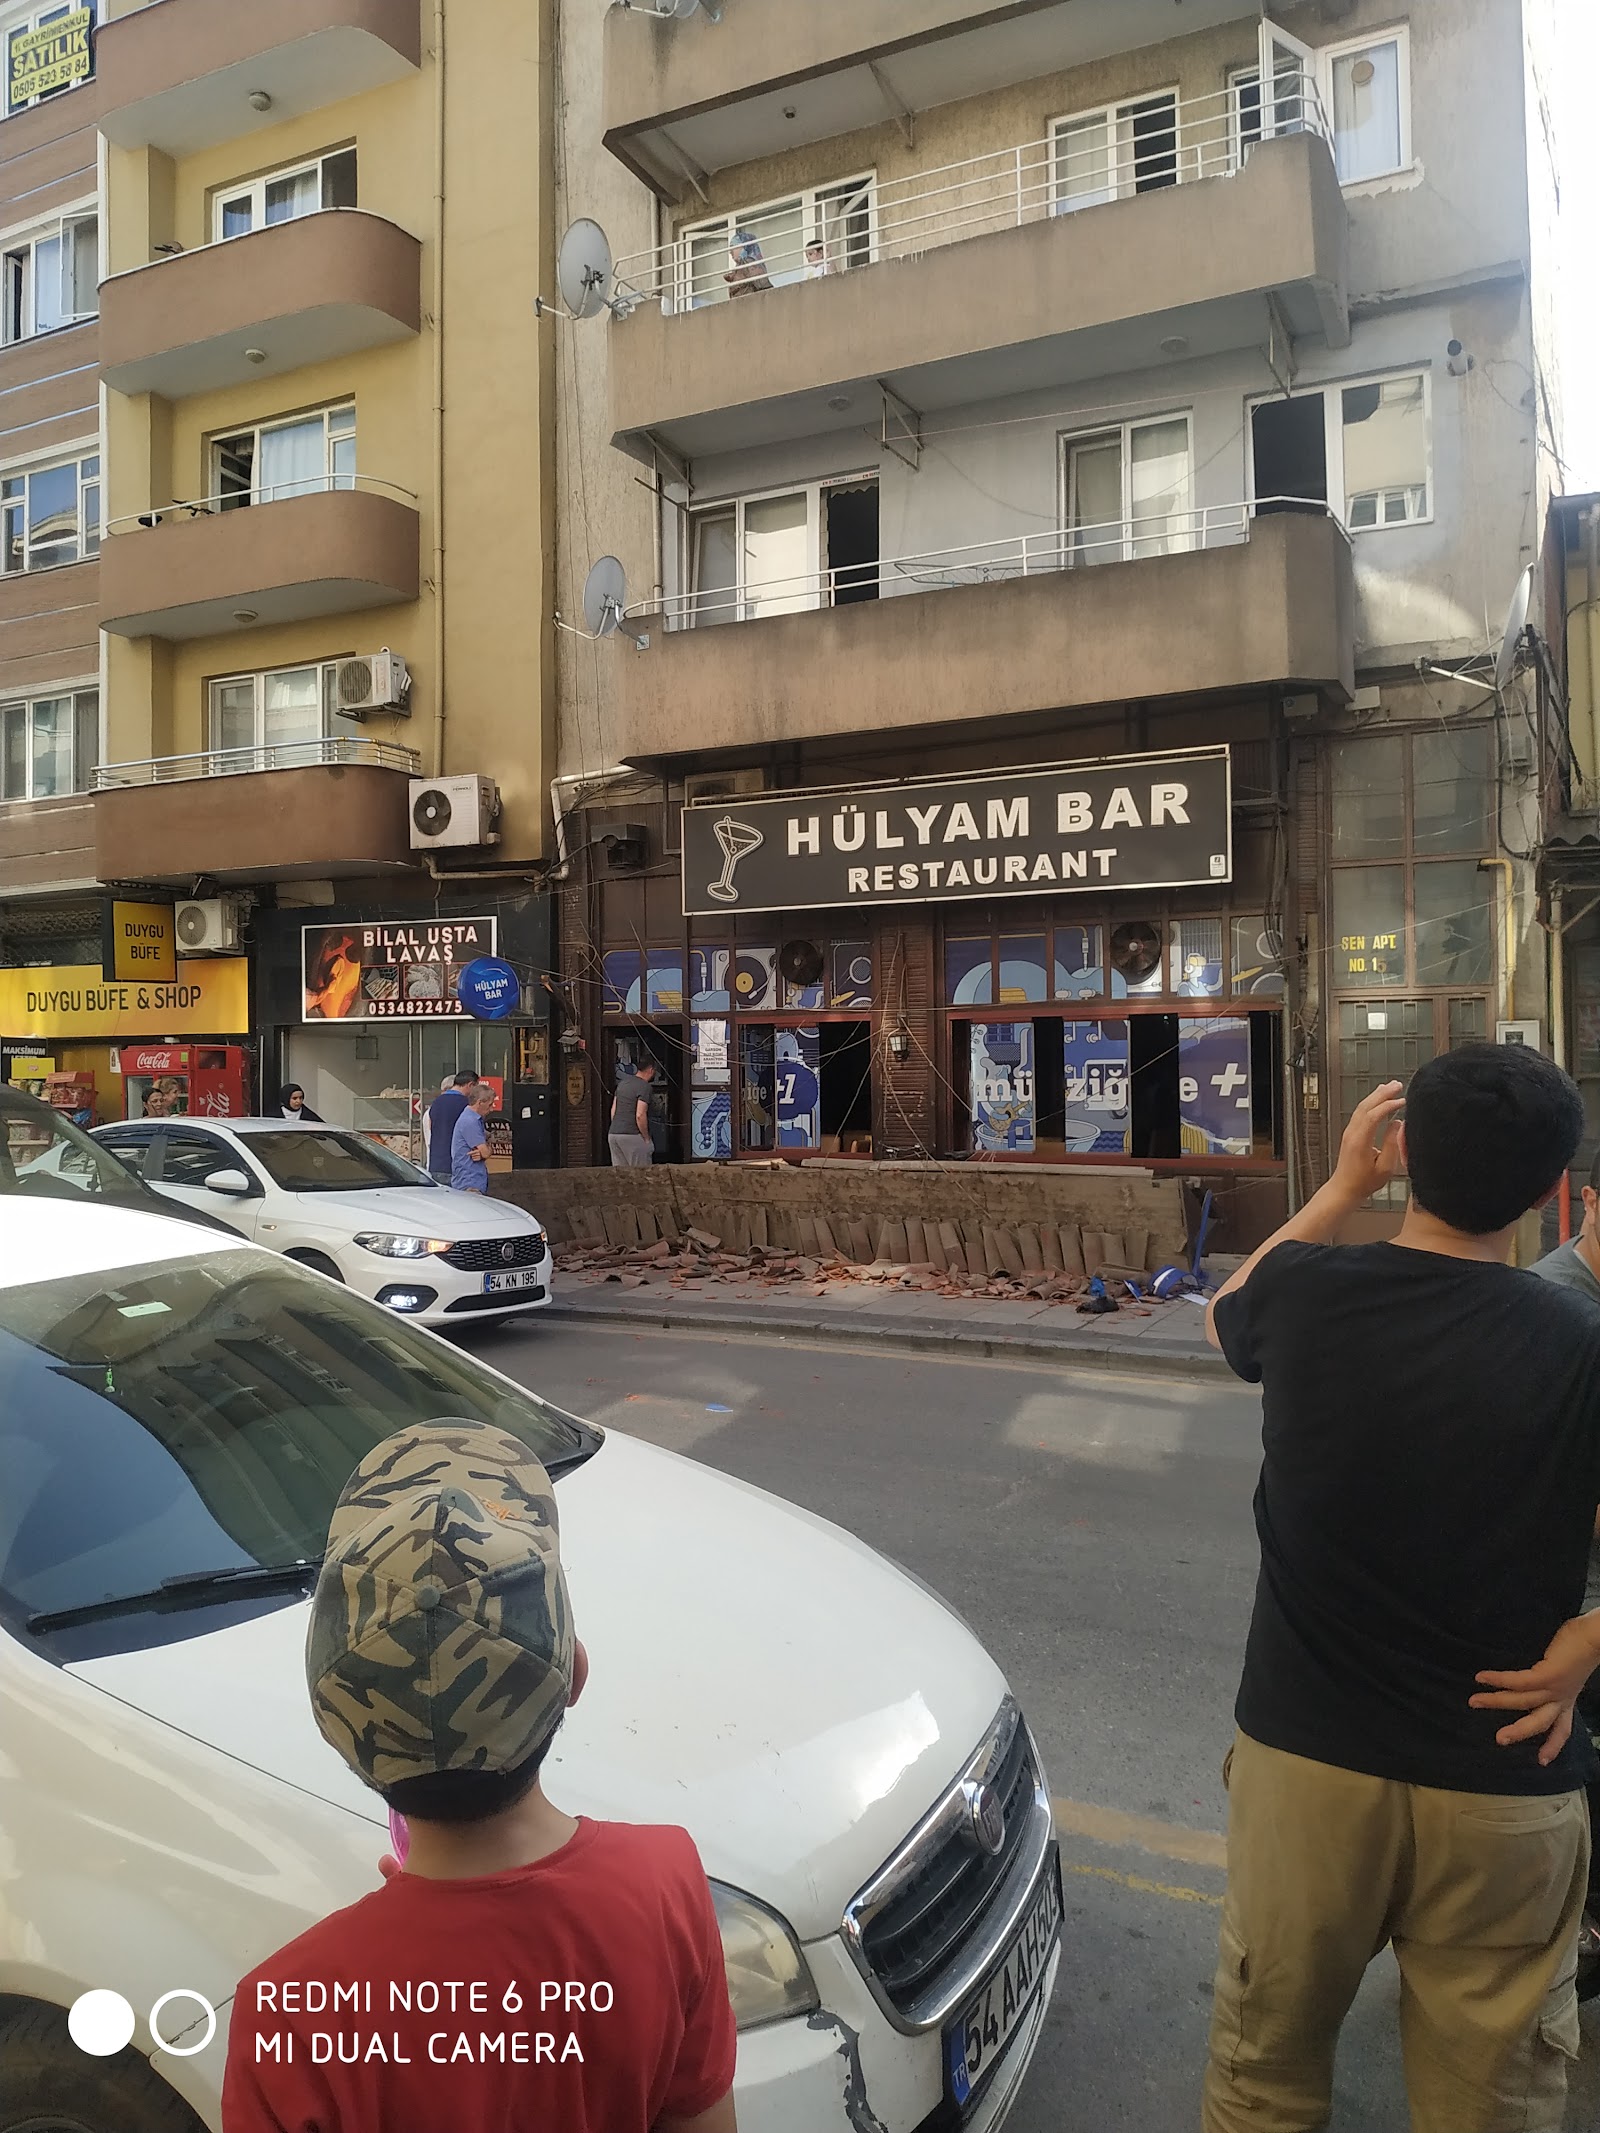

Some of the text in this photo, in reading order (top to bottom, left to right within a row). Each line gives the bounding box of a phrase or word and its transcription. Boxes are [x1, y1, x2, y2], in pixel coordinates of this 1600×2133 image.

[13, 27, 88, 79] SATILIK
[13, 78, 36, 99] 0505
[38, 69, 57, 88] 523
[74, 56, 87, 74] 84
[786, 782, 1192, 857] HÜLYAM BAR
[847, 848, 1119, 894] RESTAURANT
[124, 923, 164, 939] DUYGU
[363, 926, 478, 947] BİLAL USTA
[130, 942, 161, 960] BÜFE
[386, 944, 454, 965] LAVAŞ
[474, 977, 508, 992] HÜLYAM
[484, 989, 502, 1000] BAR
[27, 984, 202, 1013] DUYGU BÜFE & SHOP
[369, 1001, 463, 1015] 0534822475
[2, 1045, 46, 1056] MAKSİMUM
[490, 1271, 535, 1289] 54 KN 195
[952, 2065, 968, 2089] TR
[963, 1987, 999, 2075] 54
[1002, 1908, 1040, 2033] AAH
